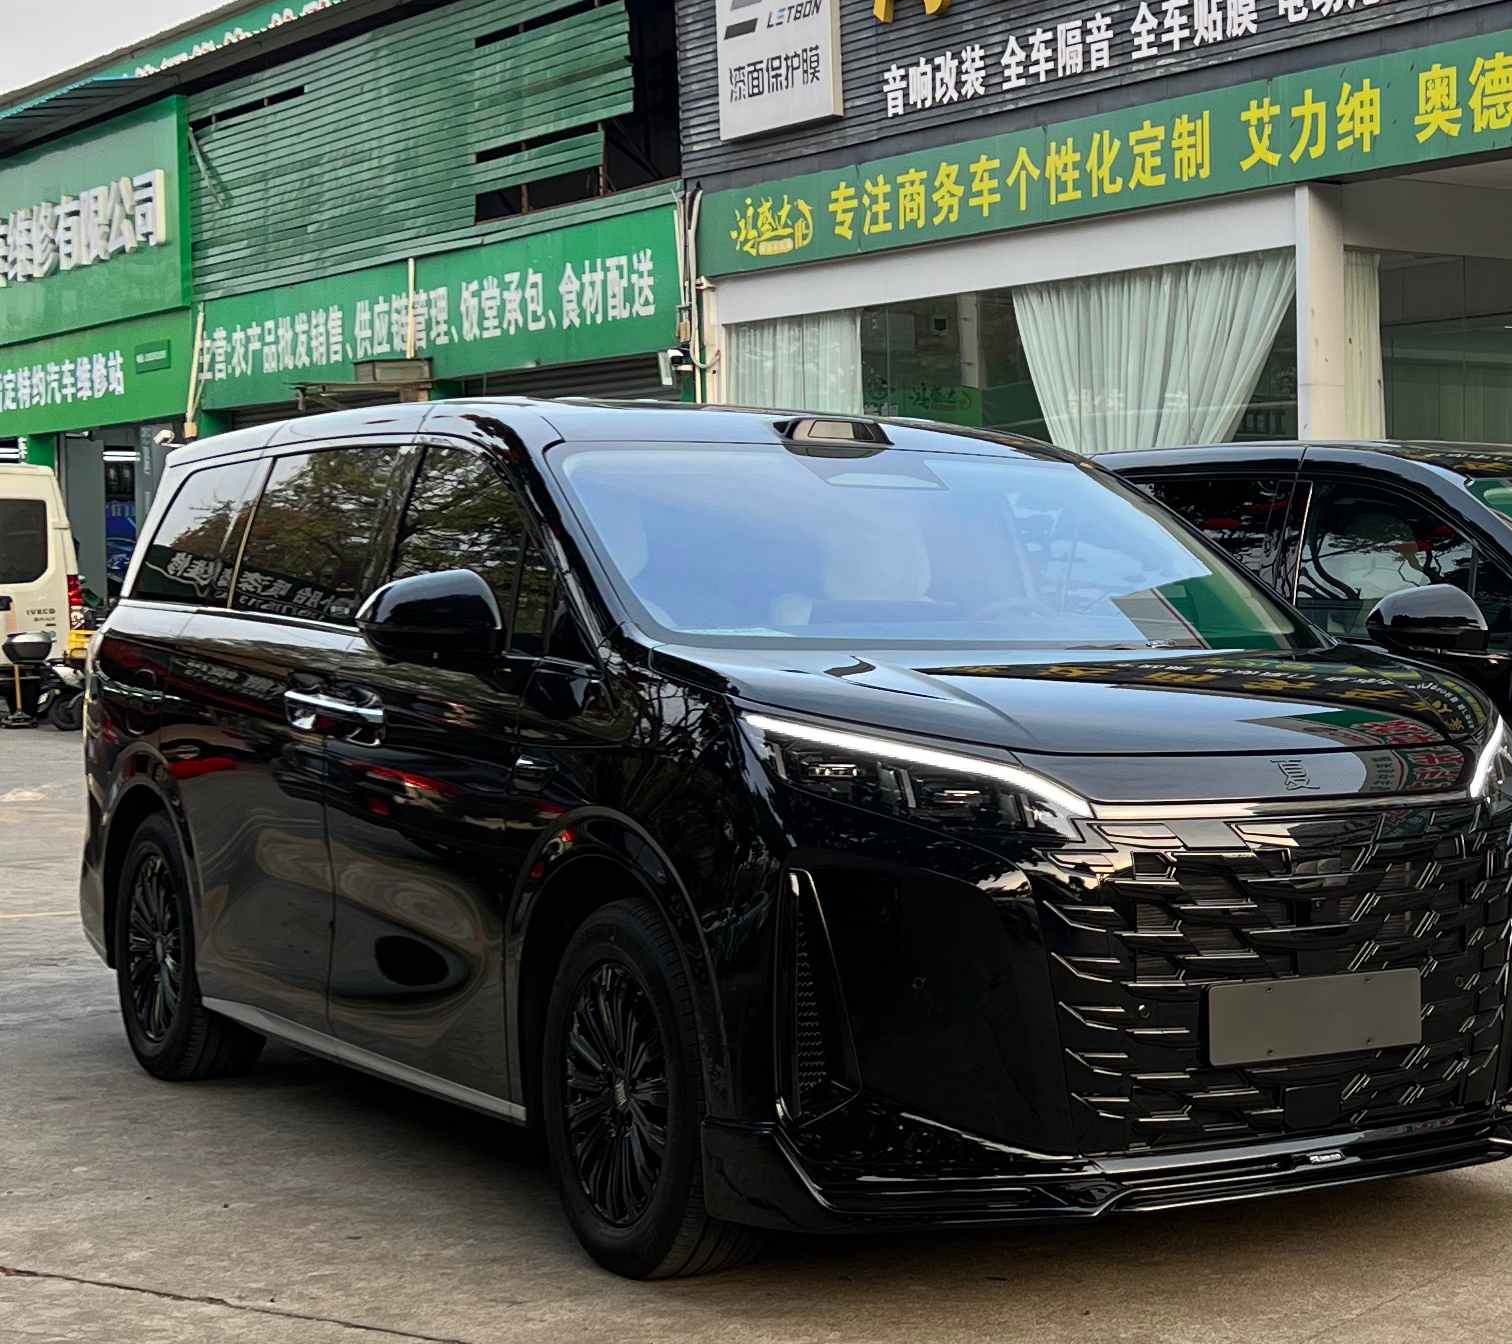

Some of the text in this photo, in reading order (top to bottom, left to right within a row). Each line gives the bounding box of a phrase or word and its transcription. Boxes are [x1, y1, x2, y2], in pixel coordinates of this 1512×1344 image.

[729, 44, 821, 103] 漆面保护膜
[883, 44, 986, 118] 音响改装
[1000, 14, 1114, 92] 全车隔音
[828, 111, 1212, 241] 专注商务车个性化定制
[1240, 79, 1382, 171] 艾力绅
[0, 350, 125, 413] 定特约汽车维修站
